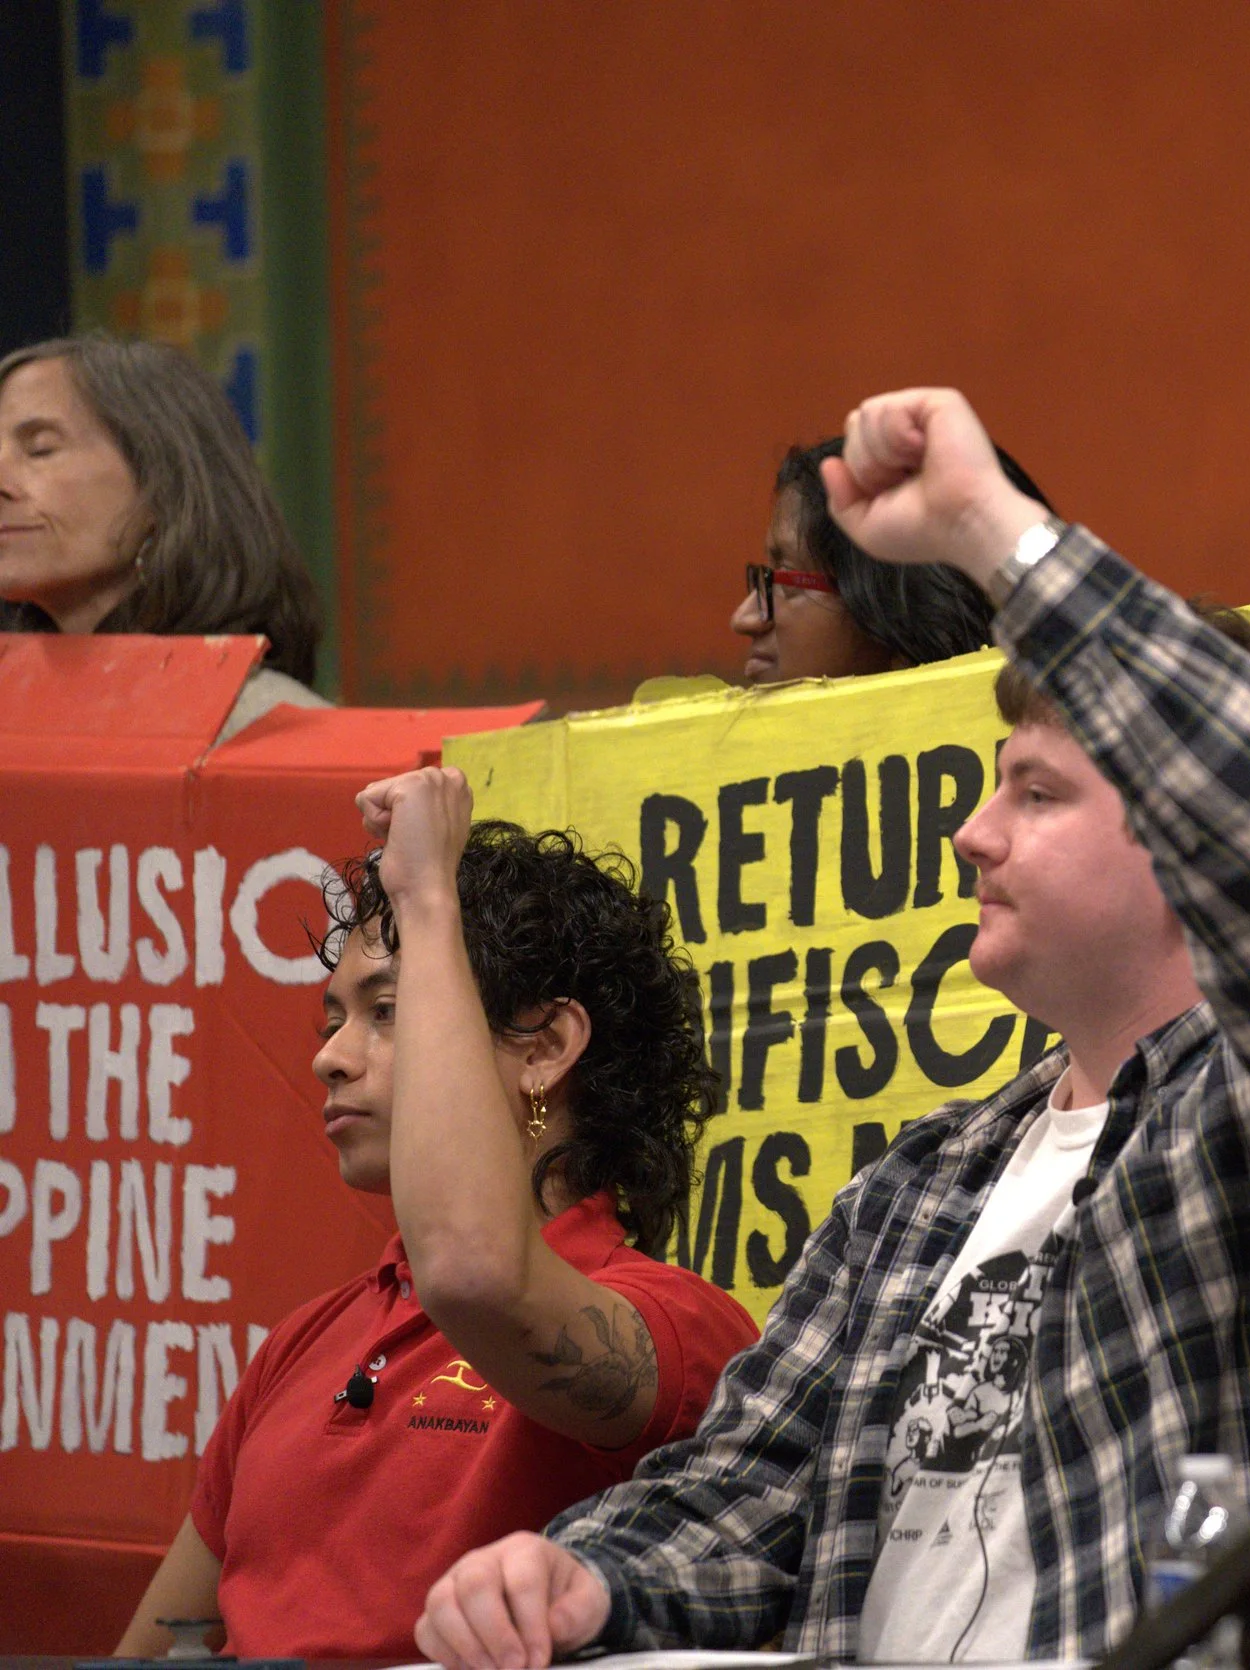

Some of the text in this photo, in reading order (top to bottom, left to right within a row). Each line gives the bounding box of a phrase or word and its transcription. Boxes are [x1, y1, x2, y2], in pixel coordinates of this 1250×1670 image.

[640, 738, 1006, 943] RETUR
[36, 1001, 194, 1147] THE
[408, 1415, 490, 1434] ANAKBAYAN
